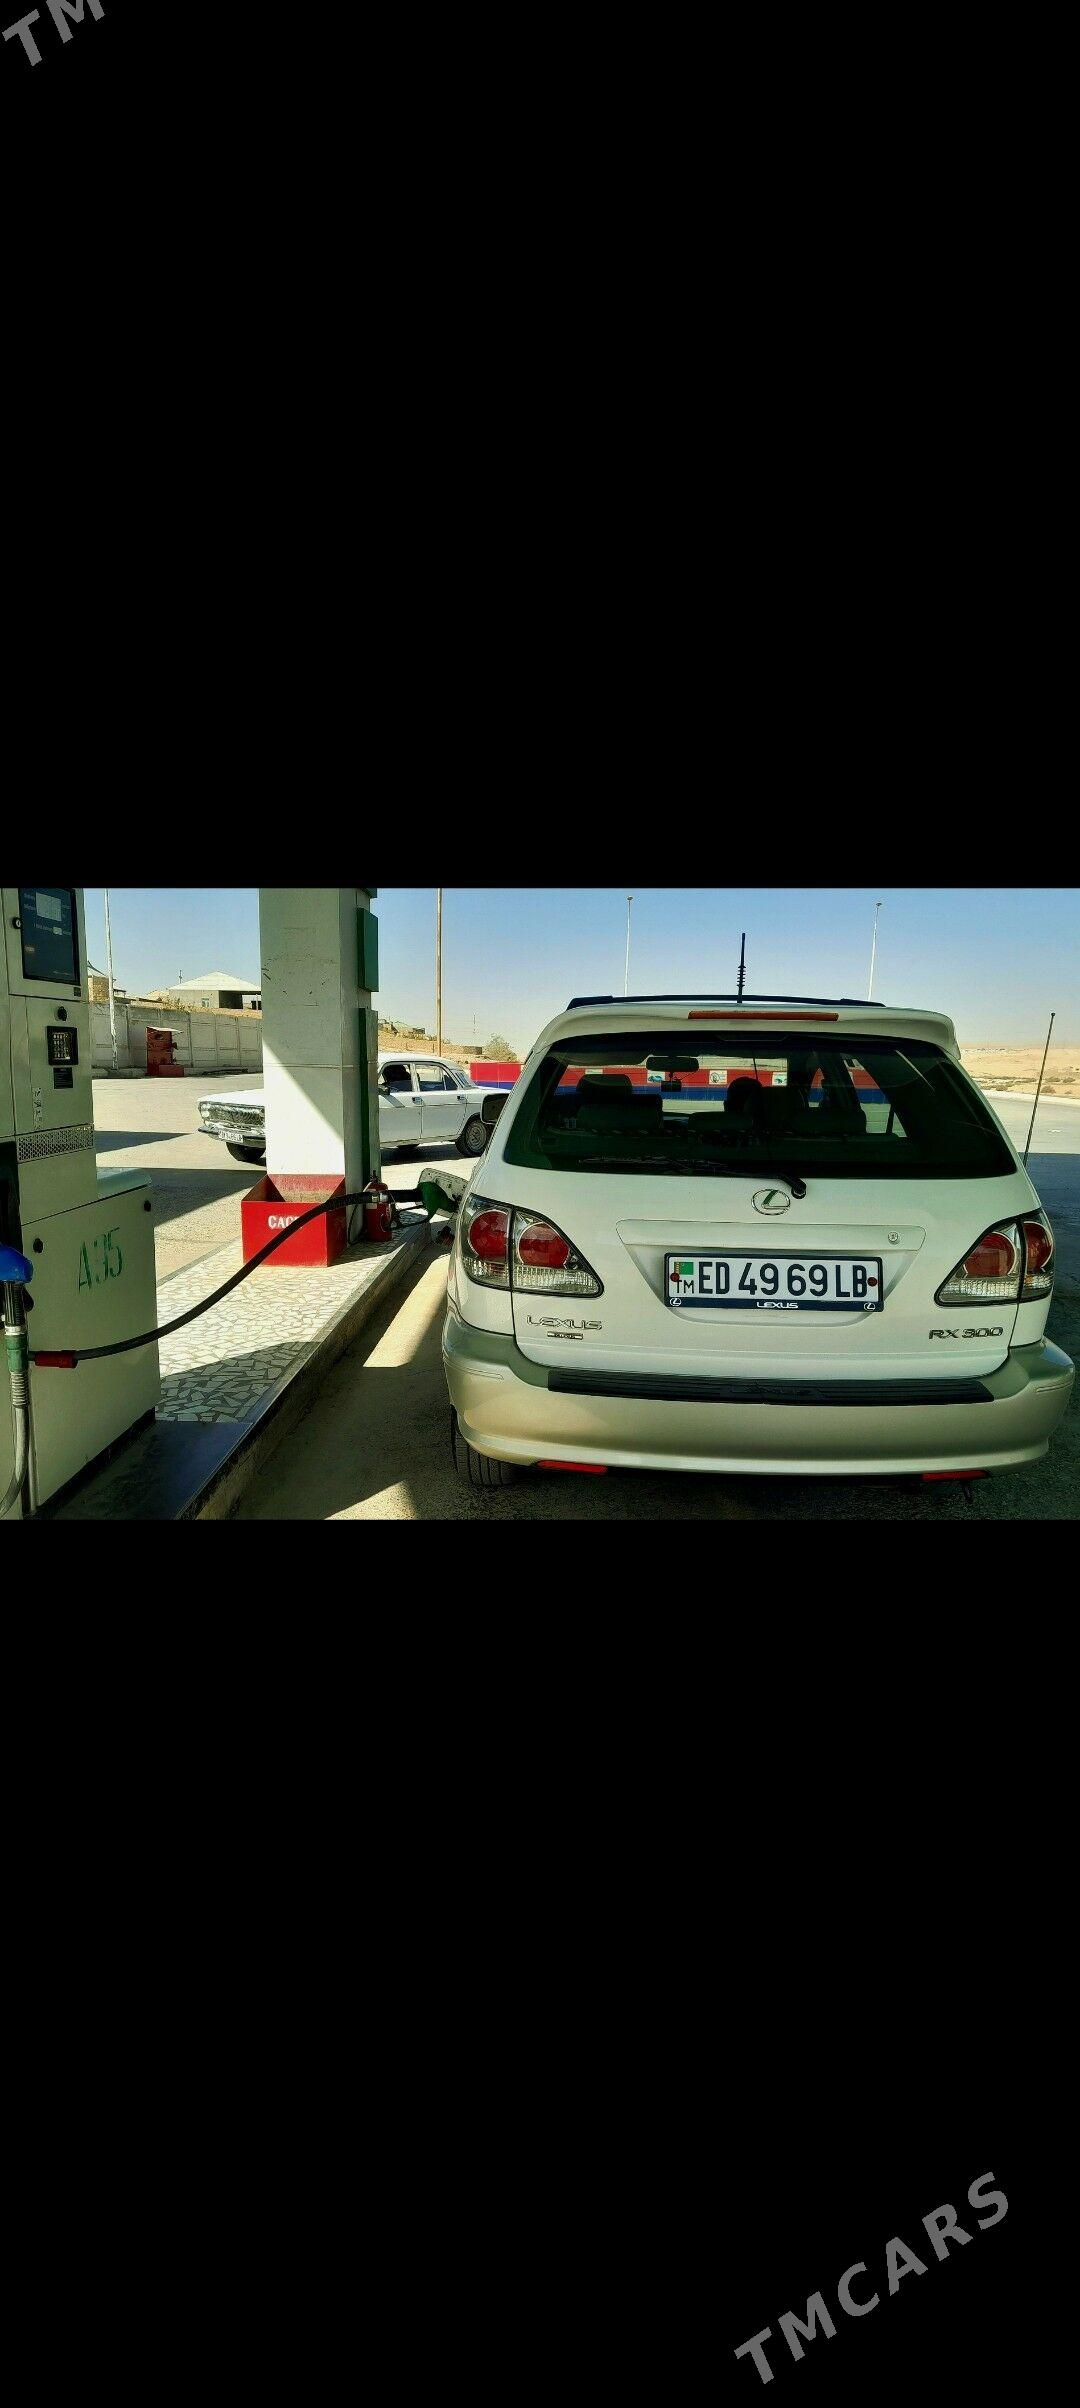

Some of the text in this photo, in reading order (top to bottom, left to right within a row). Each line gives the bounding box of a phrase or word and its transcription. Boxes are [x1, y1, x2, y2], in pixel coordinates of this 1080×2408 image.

[675, 1279, 695, 1295] TM
[698, 1261, 868, 1298] ED 49 69 LB
[756, 1301, 799, 1309] LEXUS
[526, 1315, 603, 1330] LEXUS
[928, 1326, 1004, 1340] RX 300
